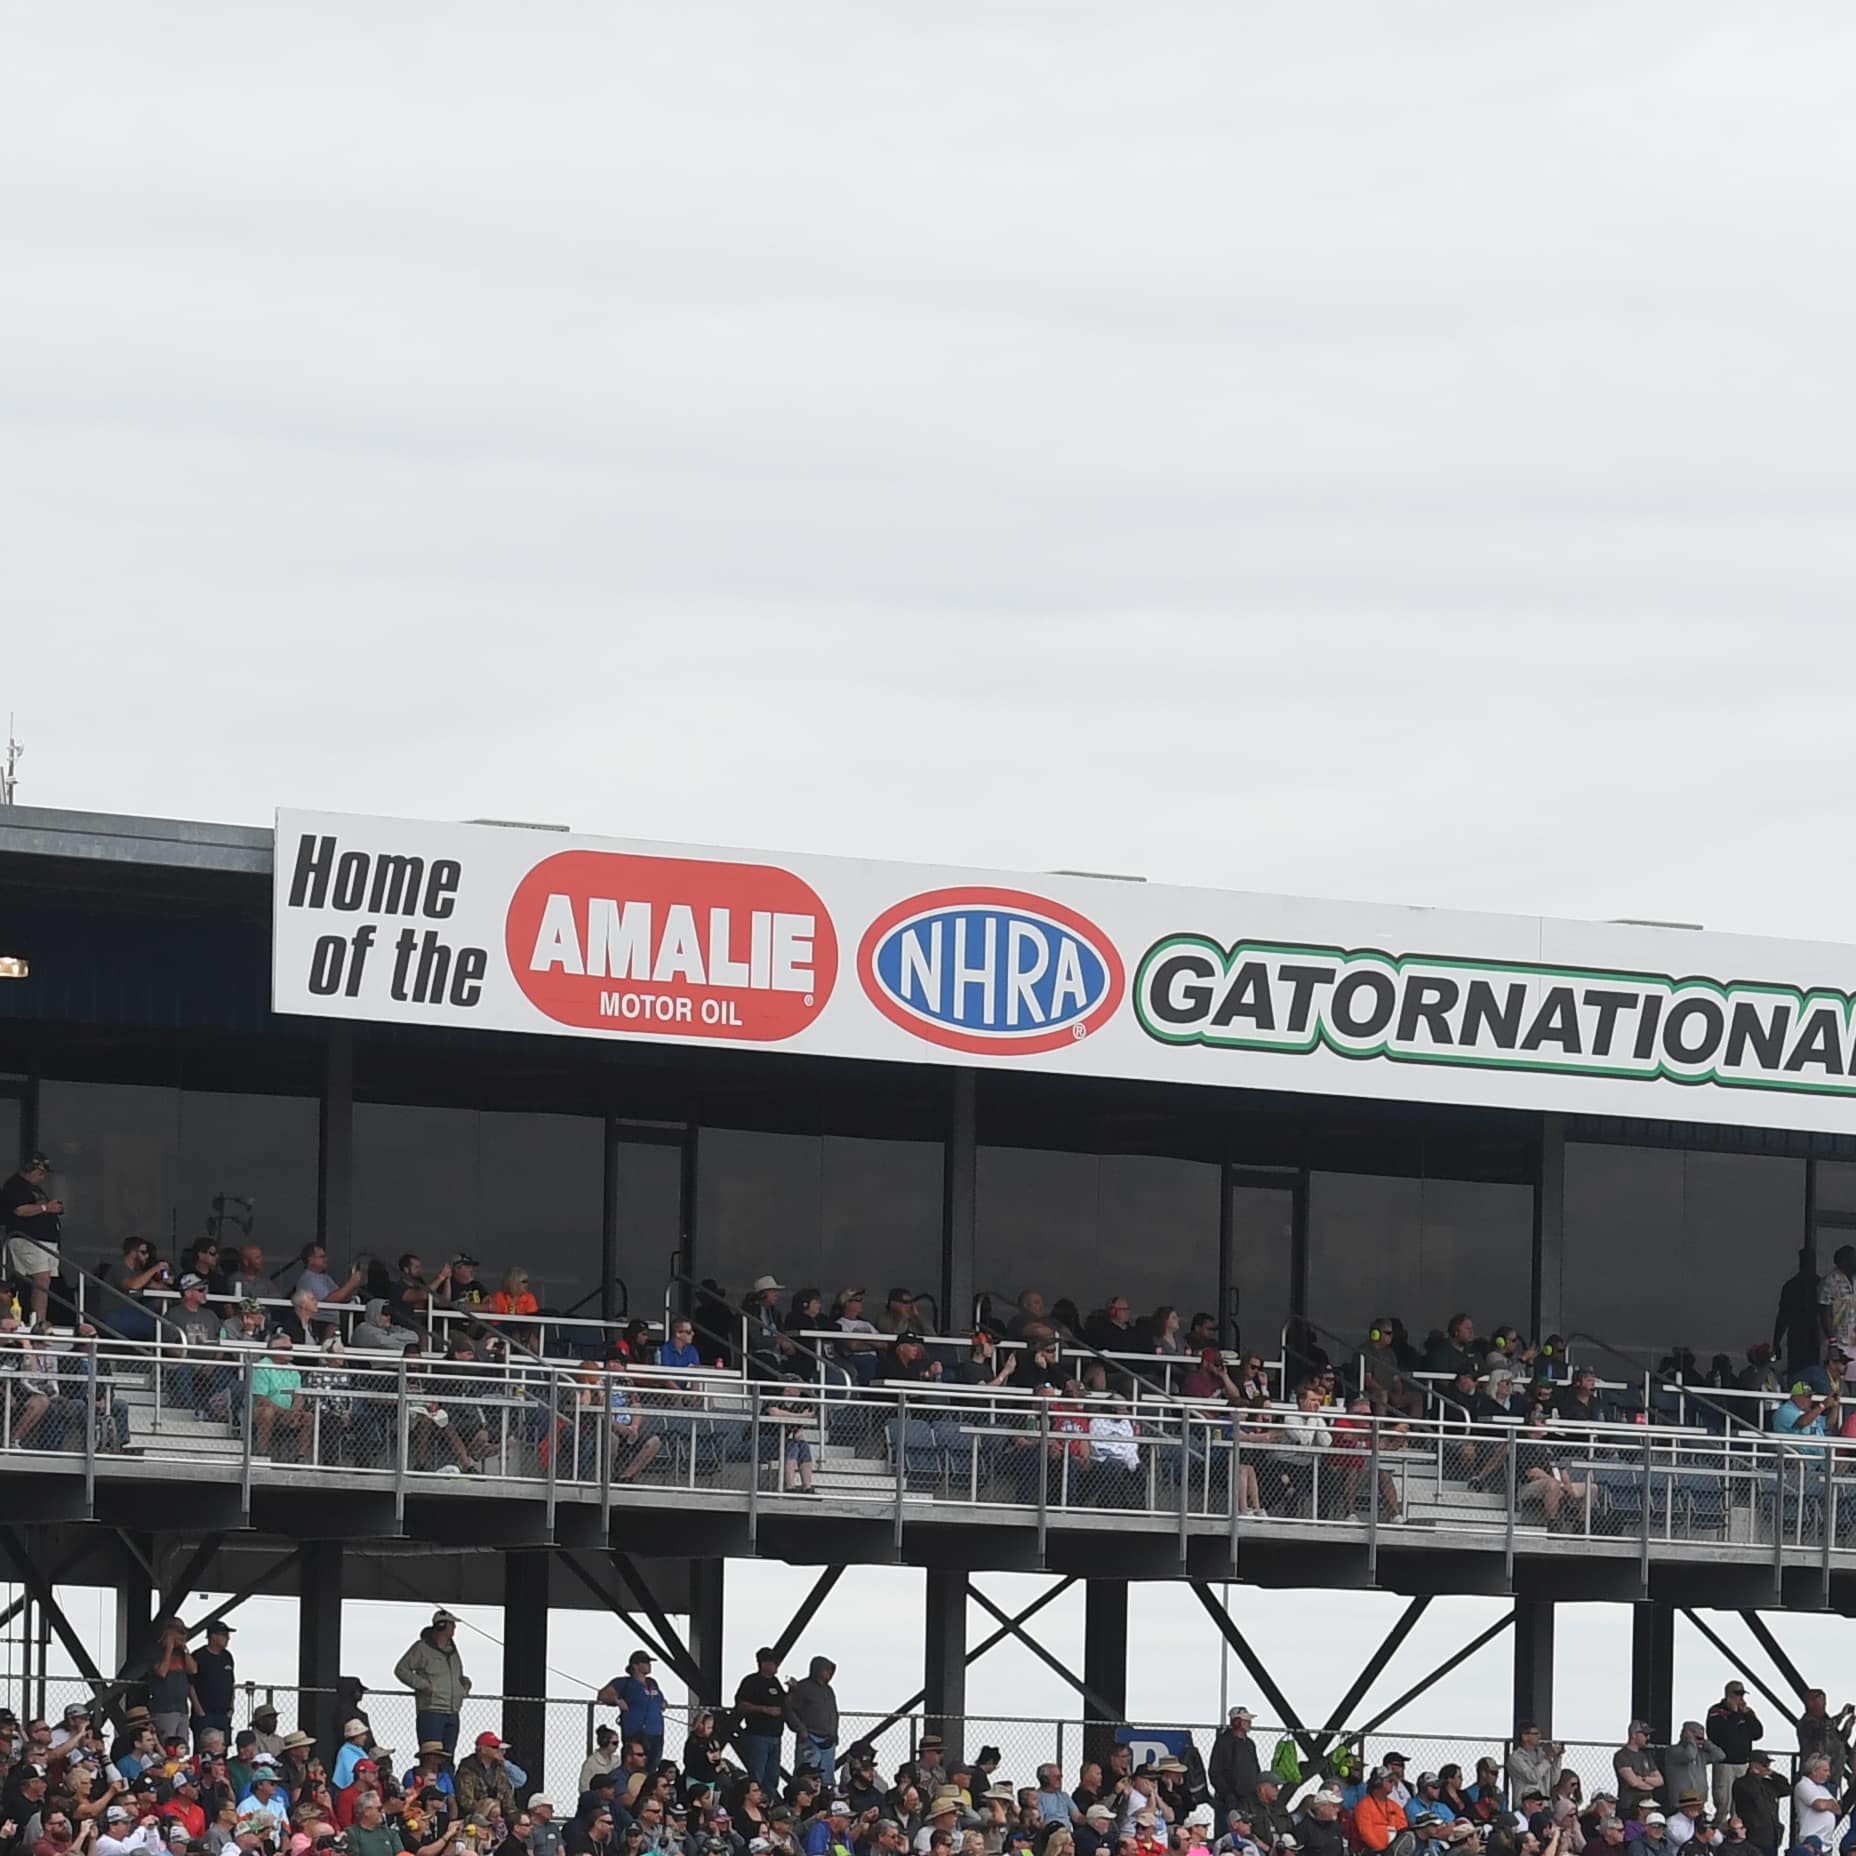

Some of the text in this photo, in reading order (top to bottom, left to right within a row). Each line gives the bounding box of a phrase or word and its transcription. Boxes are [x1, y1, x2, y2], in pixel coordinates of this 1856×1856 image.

[287, 834, 462, 919] Home
[308, 925, 488, 1008] of the
[529, 893, 816, 993] AMALIE
[900, 915, 1088, 1026] NHRA
[600, 990, 743, 1027] MOTOR OIL
